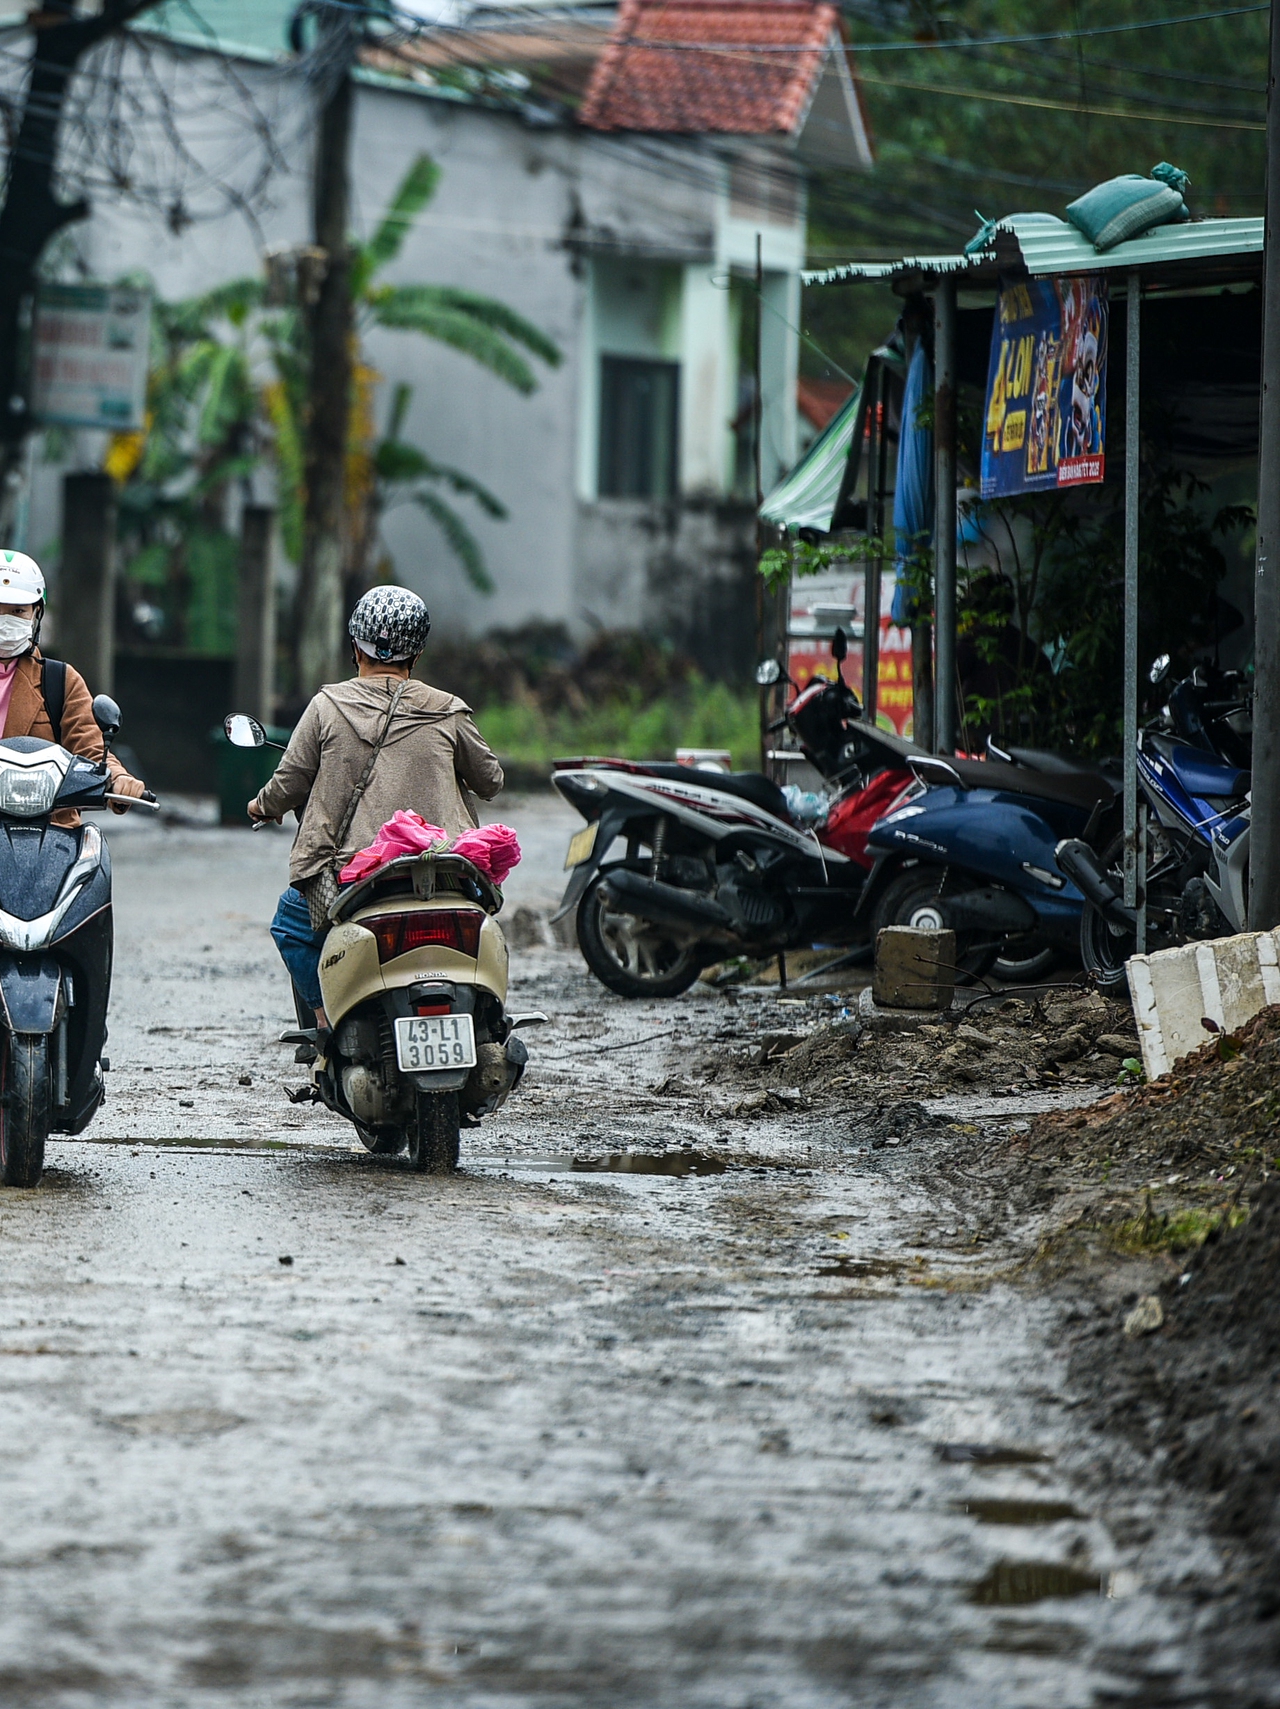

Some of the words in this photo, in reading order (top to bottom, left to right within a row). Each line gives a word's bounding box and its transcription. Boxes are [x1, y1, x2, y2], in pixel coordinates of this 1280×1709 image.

[1218, 833, 1231, 845] 150
[415, 971, 447, 980] HONDA
[408, 1019, 459, 1043] 43-L1
[409, 1043, 464, 1067] 3059
